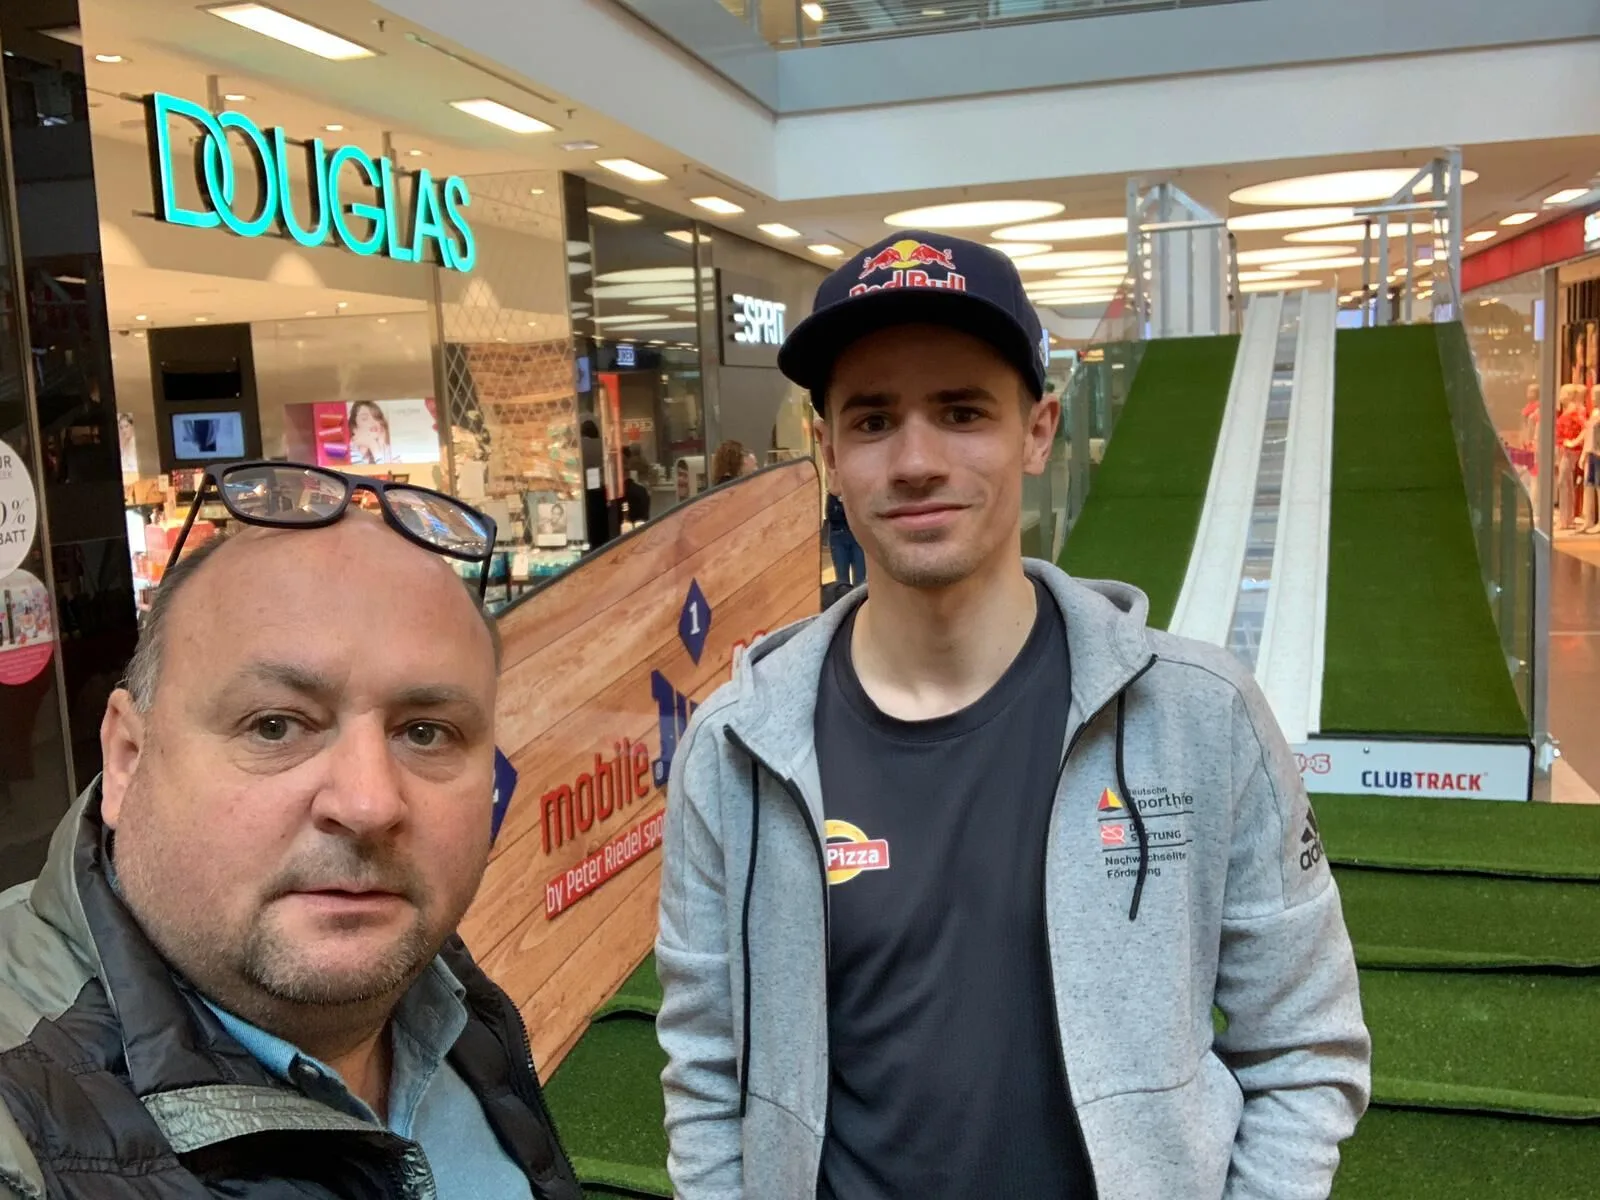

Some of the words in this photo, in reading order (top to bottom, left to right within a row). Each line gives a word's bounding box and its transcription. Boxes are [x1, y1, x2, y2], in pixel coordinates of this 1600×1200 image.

[153, 91, 475, 272] DOUGLAS
[732, 293, 786, 345] ESPRIT
[688, 601, 701, 636] 1
[1128, 786, 1168, 796] eutsche
[1361, 770, 1482, 792] CLUBTRACK
[540, 736, 649, 856] mobile
[1130, 830, 1182, 842] SFTUNG
[546, 879, 564, 914] by
[566, 854, 602, 899] Peter
[604, 823, 642, 874] Riedel
[827, 847, 880, 868] Pizza
[1107, 867, 1161, 879] Fördeng
